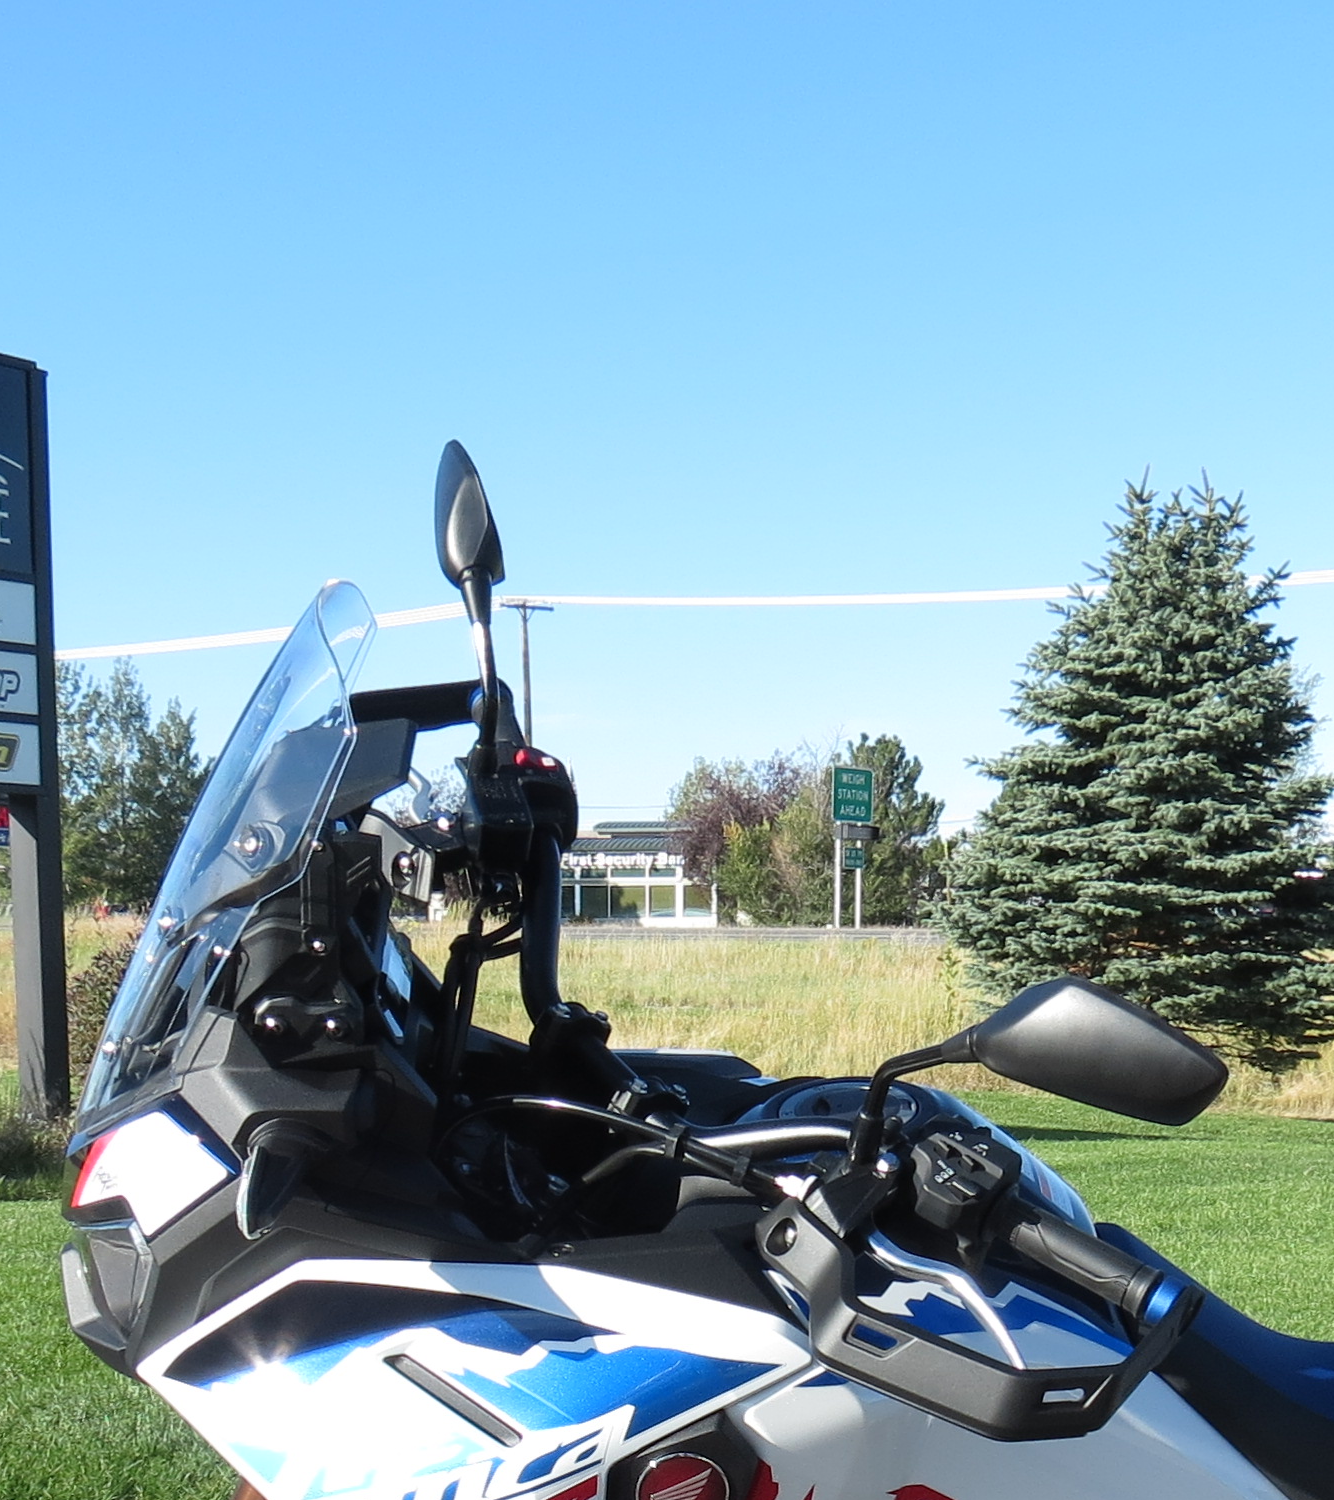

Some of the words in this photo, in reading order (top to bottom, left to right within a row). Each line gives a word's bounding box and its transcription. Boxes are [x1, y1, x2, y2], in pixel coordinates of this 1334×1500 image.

[842, 773, 866, 785] WEIGH
[837, 788, 869, 801] STATION
[839, 805, 866, 817] AHEAD
[561, 852, 593, 867] First
[594, 852, 654, 868] Security
[655, 852, 687, 866] Ban
